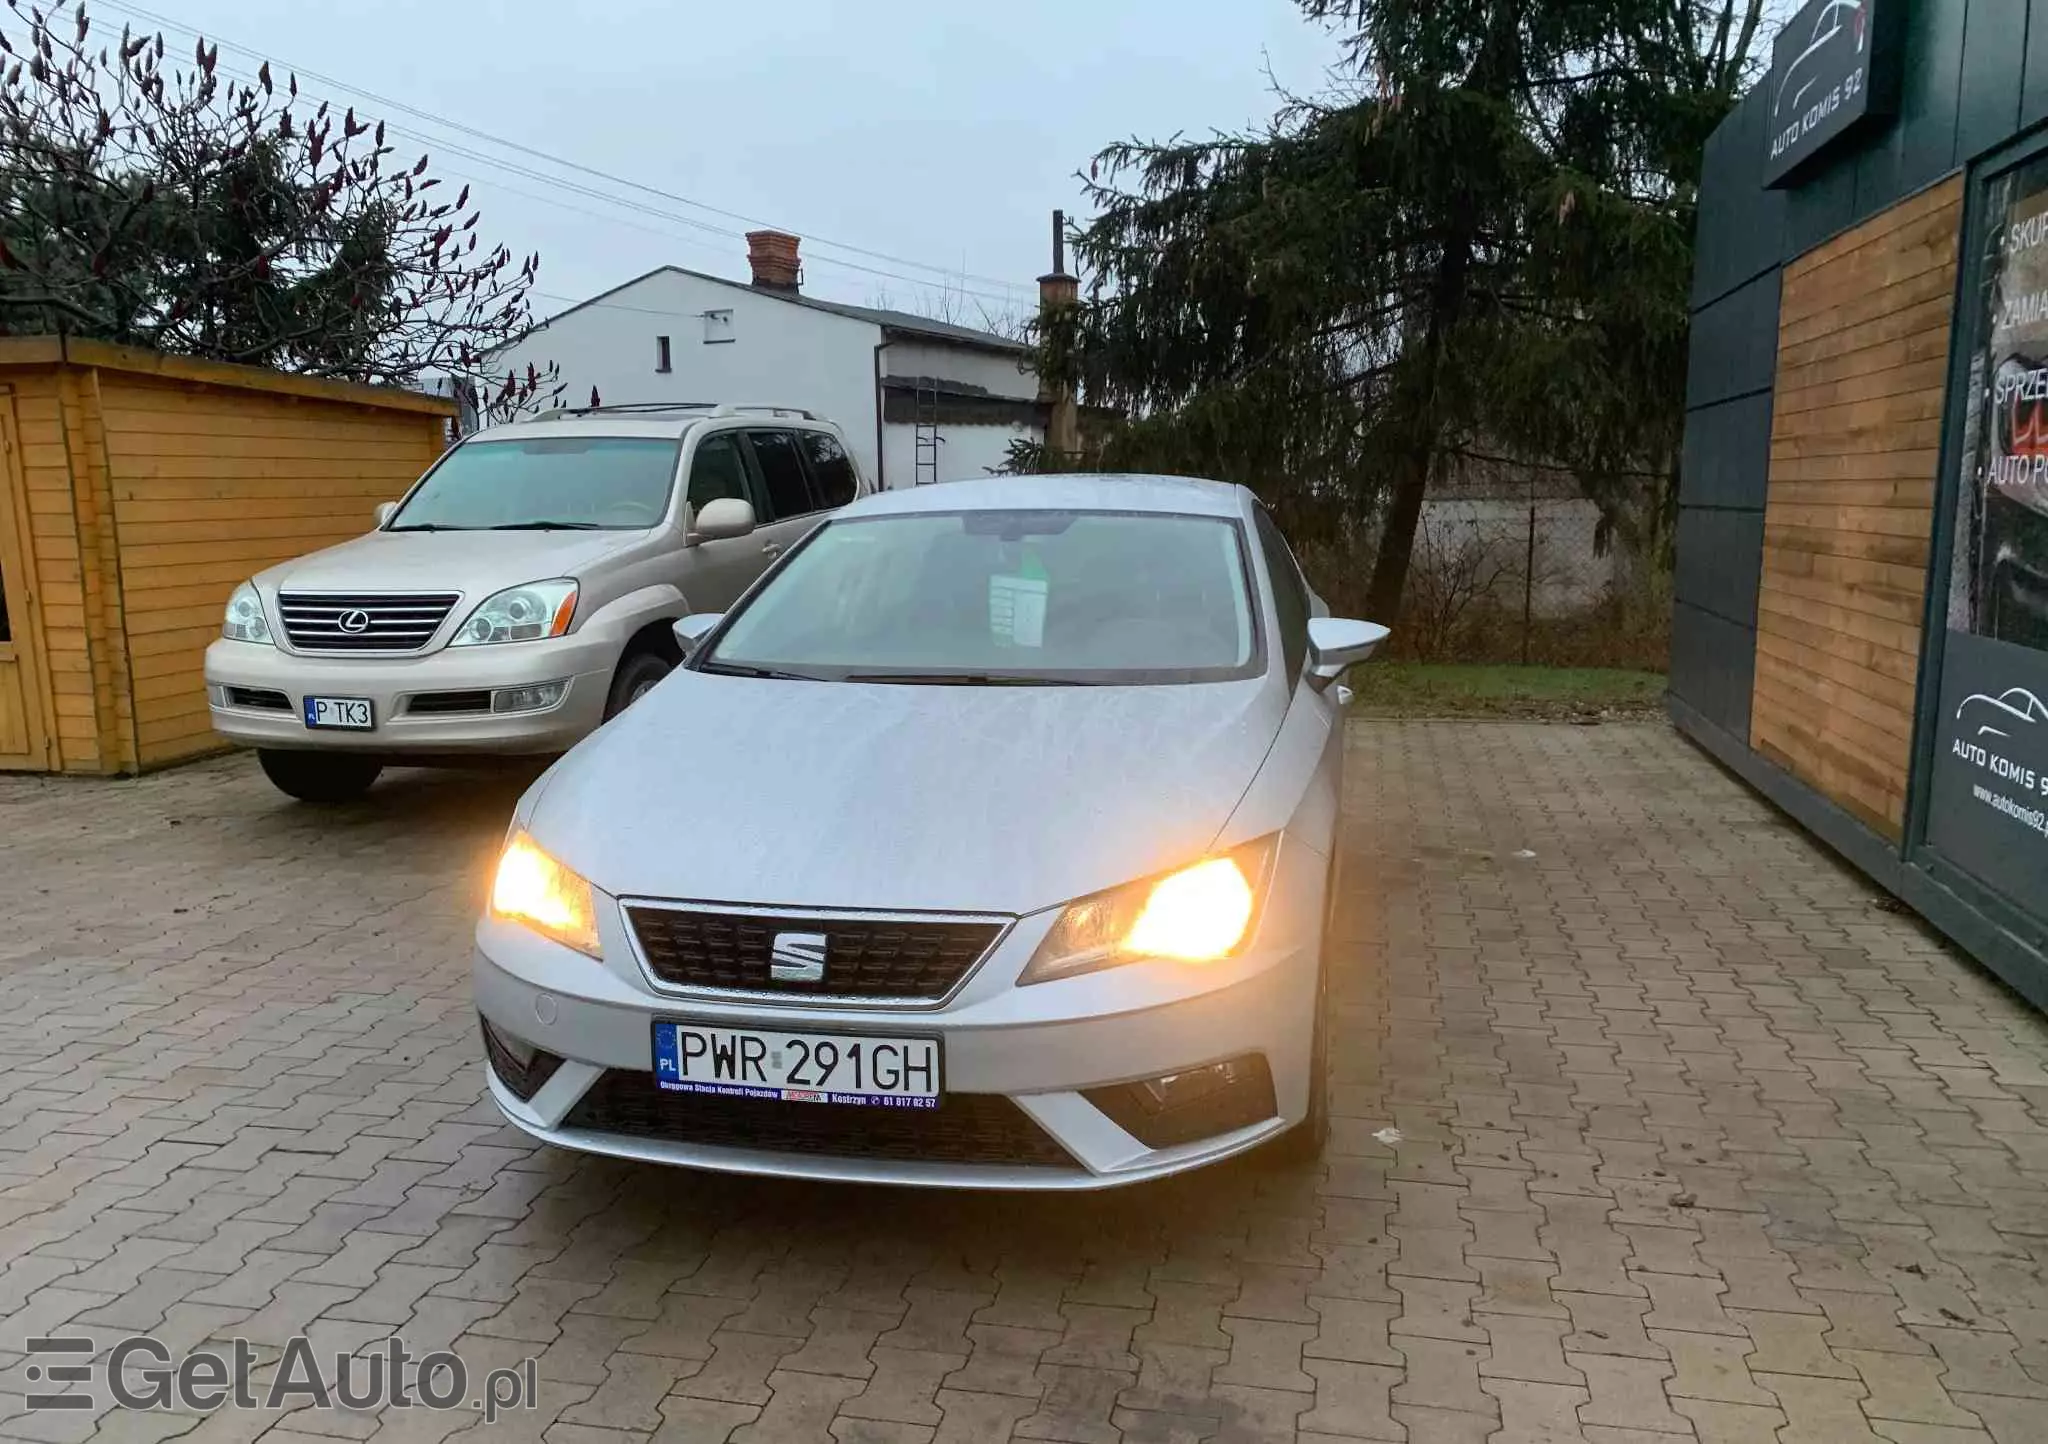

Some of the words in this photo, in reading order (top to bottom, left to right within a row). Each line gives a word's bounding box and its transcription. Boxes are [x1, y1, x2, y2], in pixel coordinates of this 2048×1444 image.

[1770, 120, 1800, 160] AUTO
[1801, 85, 1841, 136] KOMIS
[1844, 67, 1863, 100] 92
[1994, 367, 2048, 405] SPRZE
[1987, 454, 2030, 485] AUTO
[316, 701, 328, 722] P
[333, 702, 369, 724] TK3
[1952, 738, 1986, 767] AUTO
[1989, 754, 2036, 790] KOMIS
[660, 1058, 676, 1072] PL
[681, 1031, 767, 1082] PWR
[785, 1039, 932, 1092] 291GH
[832, 1094, 867, 1105] Kostrzyn
